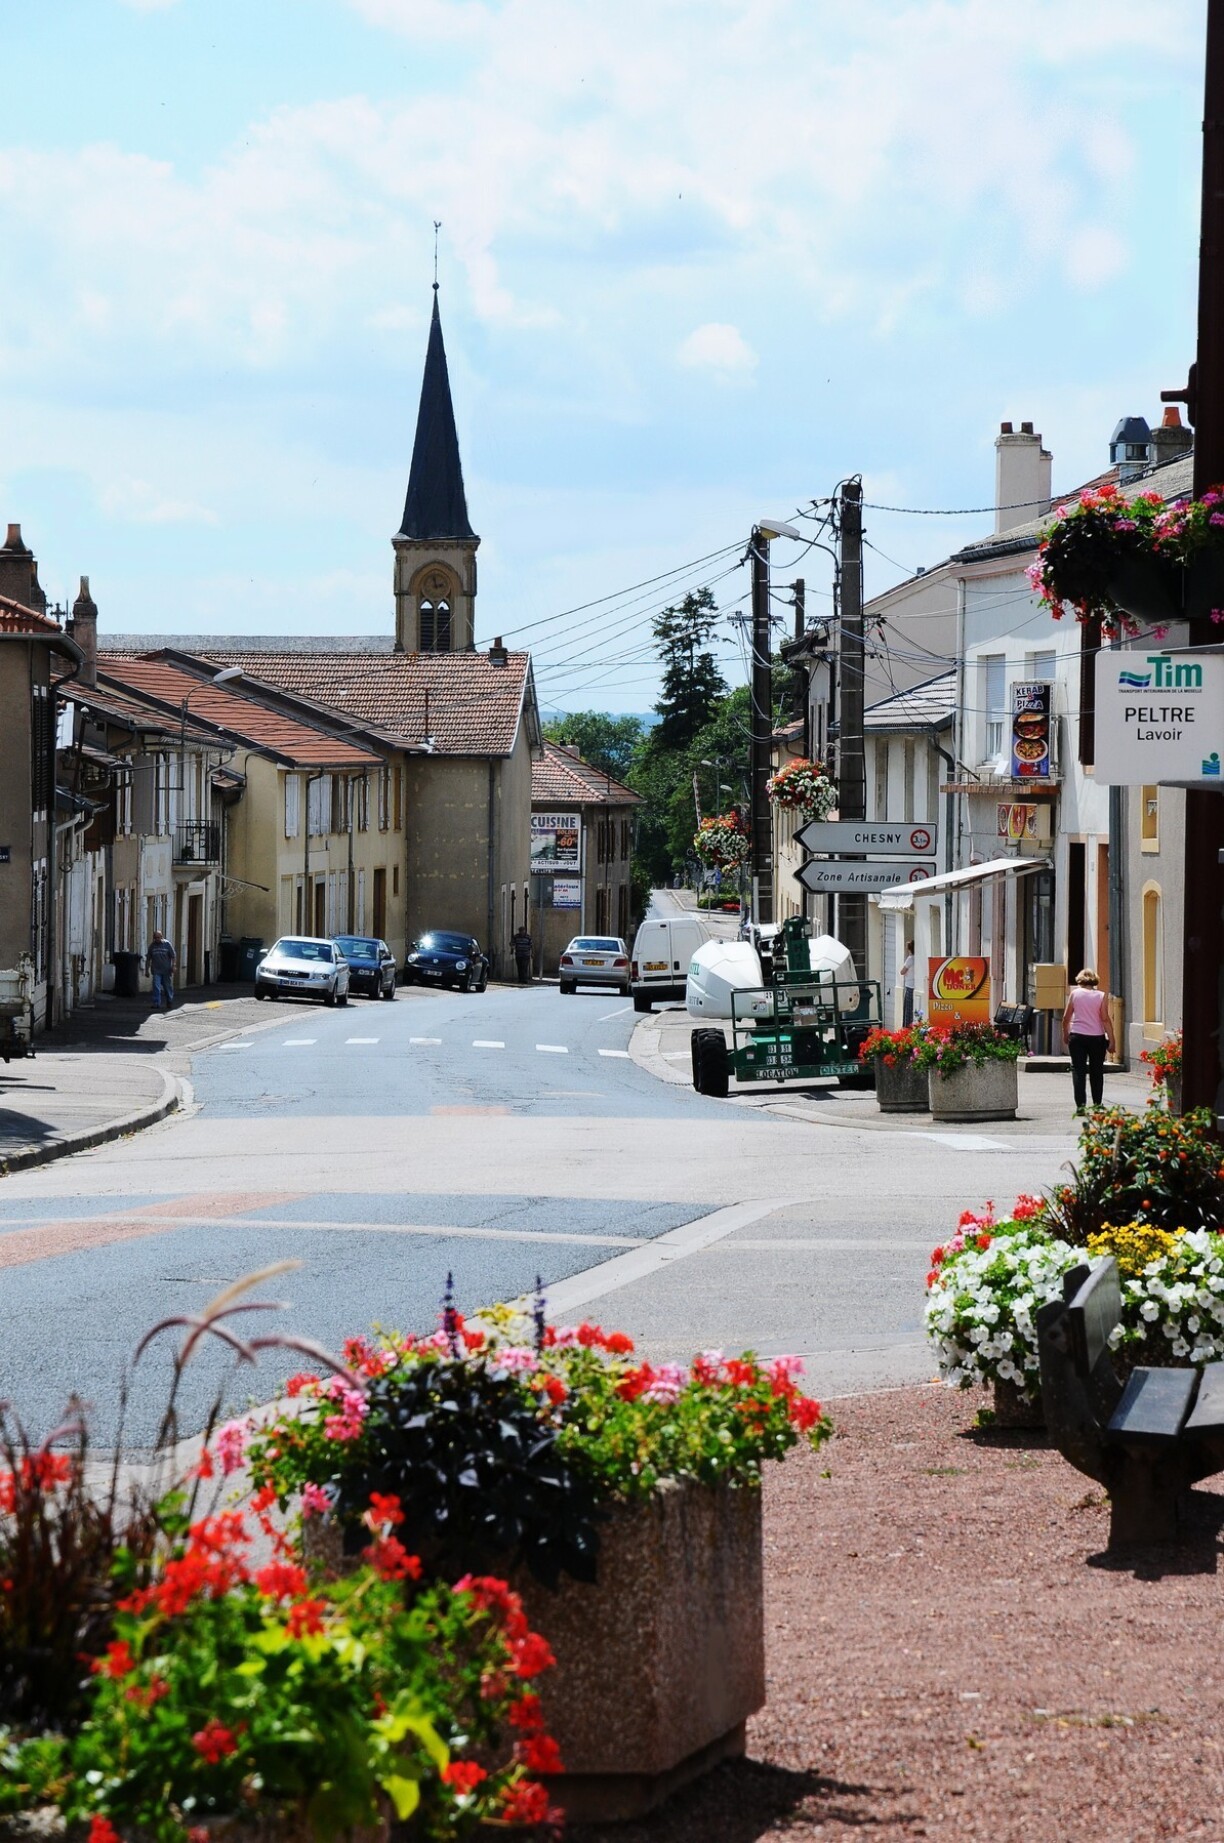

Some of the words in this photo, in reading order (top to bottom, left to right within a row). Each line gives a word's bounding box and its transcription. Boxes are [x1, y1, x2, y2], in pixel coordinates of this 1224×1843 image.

[1147, 656, 1202, 687] Tim
[1016, 685, 1044, 695] KEBAB
[1017, 700, 1043, 709] PIZZA
[1125, 707, 1195, 722] PELTRE
[1137, 728, 1182, 740] Lavoir
[854, 833, 902, 844] CHESNY
[817, 871, 842, 881] Zone
[848, 872, 901, 883] Artisanale
[756, 1068, 799, 1079] LOCATION
